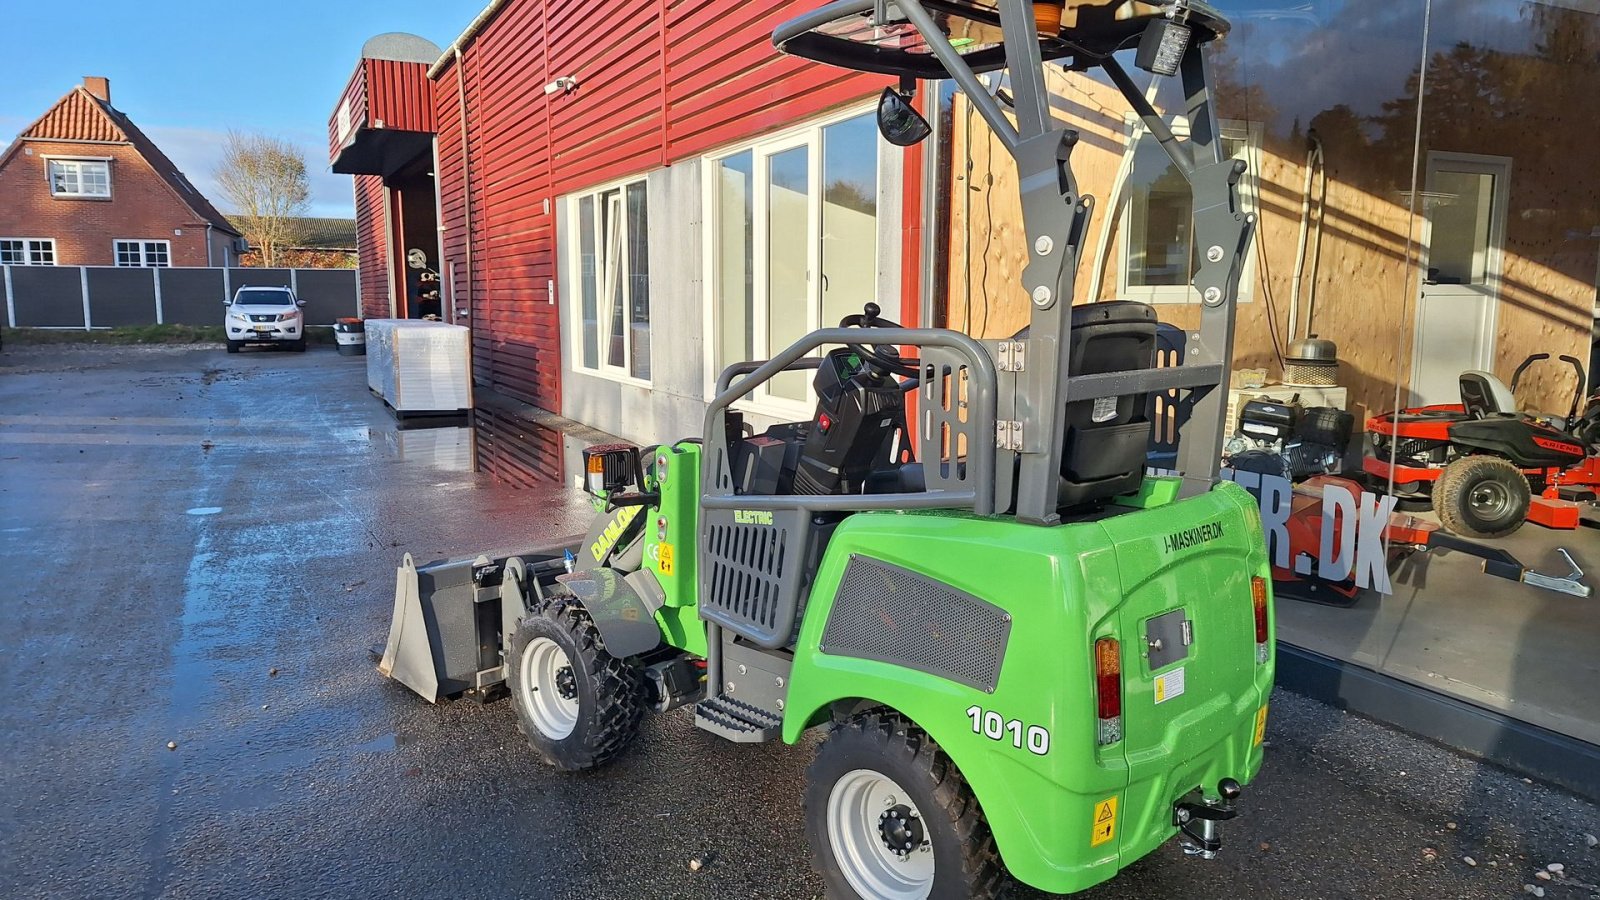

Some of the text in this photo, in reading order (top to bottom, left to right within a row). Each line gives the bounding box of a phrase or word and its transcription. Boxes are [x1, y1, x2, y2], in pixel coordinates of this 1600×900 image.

[1541, 441, 1580, 453] ARIENS
[734, 510, 773, 525] ELECTRIC
[1164, 521, 1224, 554] J-MASKINER.DK
[966, 704, 1050, 756] 1010
